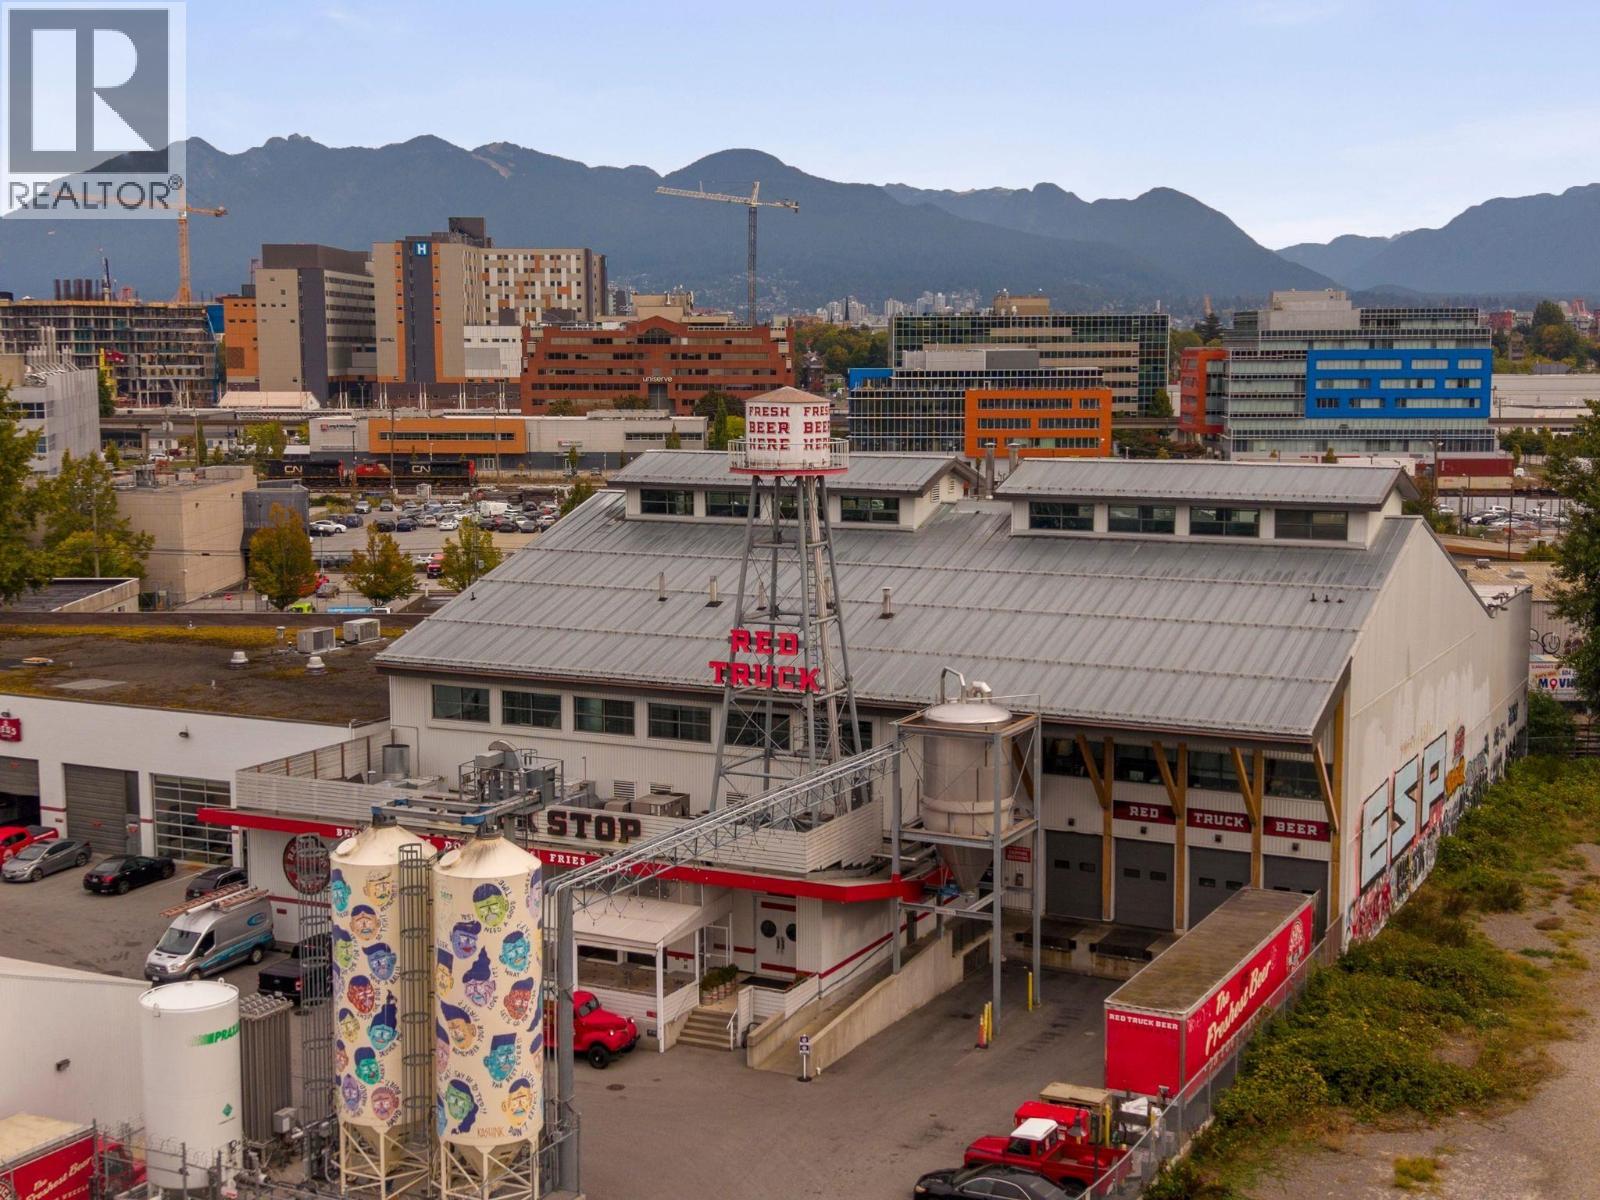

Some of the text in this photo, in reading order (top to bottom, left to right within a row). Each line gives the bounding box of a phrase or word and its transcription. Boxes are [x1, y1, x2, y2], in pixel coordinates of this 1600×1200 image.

[417, 243, 427, 255] H
[749, 406, 790, 417] FRESH
[749, 421, 790, 434] BEER
[749, 438, 790, 450] HERE
[284, 465, 303, 473] CN
[412, 465, 431, 473] CN
[730, 629, 799, 656] RED
[709, 661, 821, 694] TRUCK
[547, 809, 642, 844] STOP
[1129, 805, 1318, 836] RED TRUCK BEER
[549, 852, 586, 866] FRIES
[1205, 993, 1249, 1057] Freshest
[1248, 960, 1273, 999] Beer
[1216, 990, 1231, 1016] The
[1109, 1013, 1179, 1031] RED TRUCK BEER
